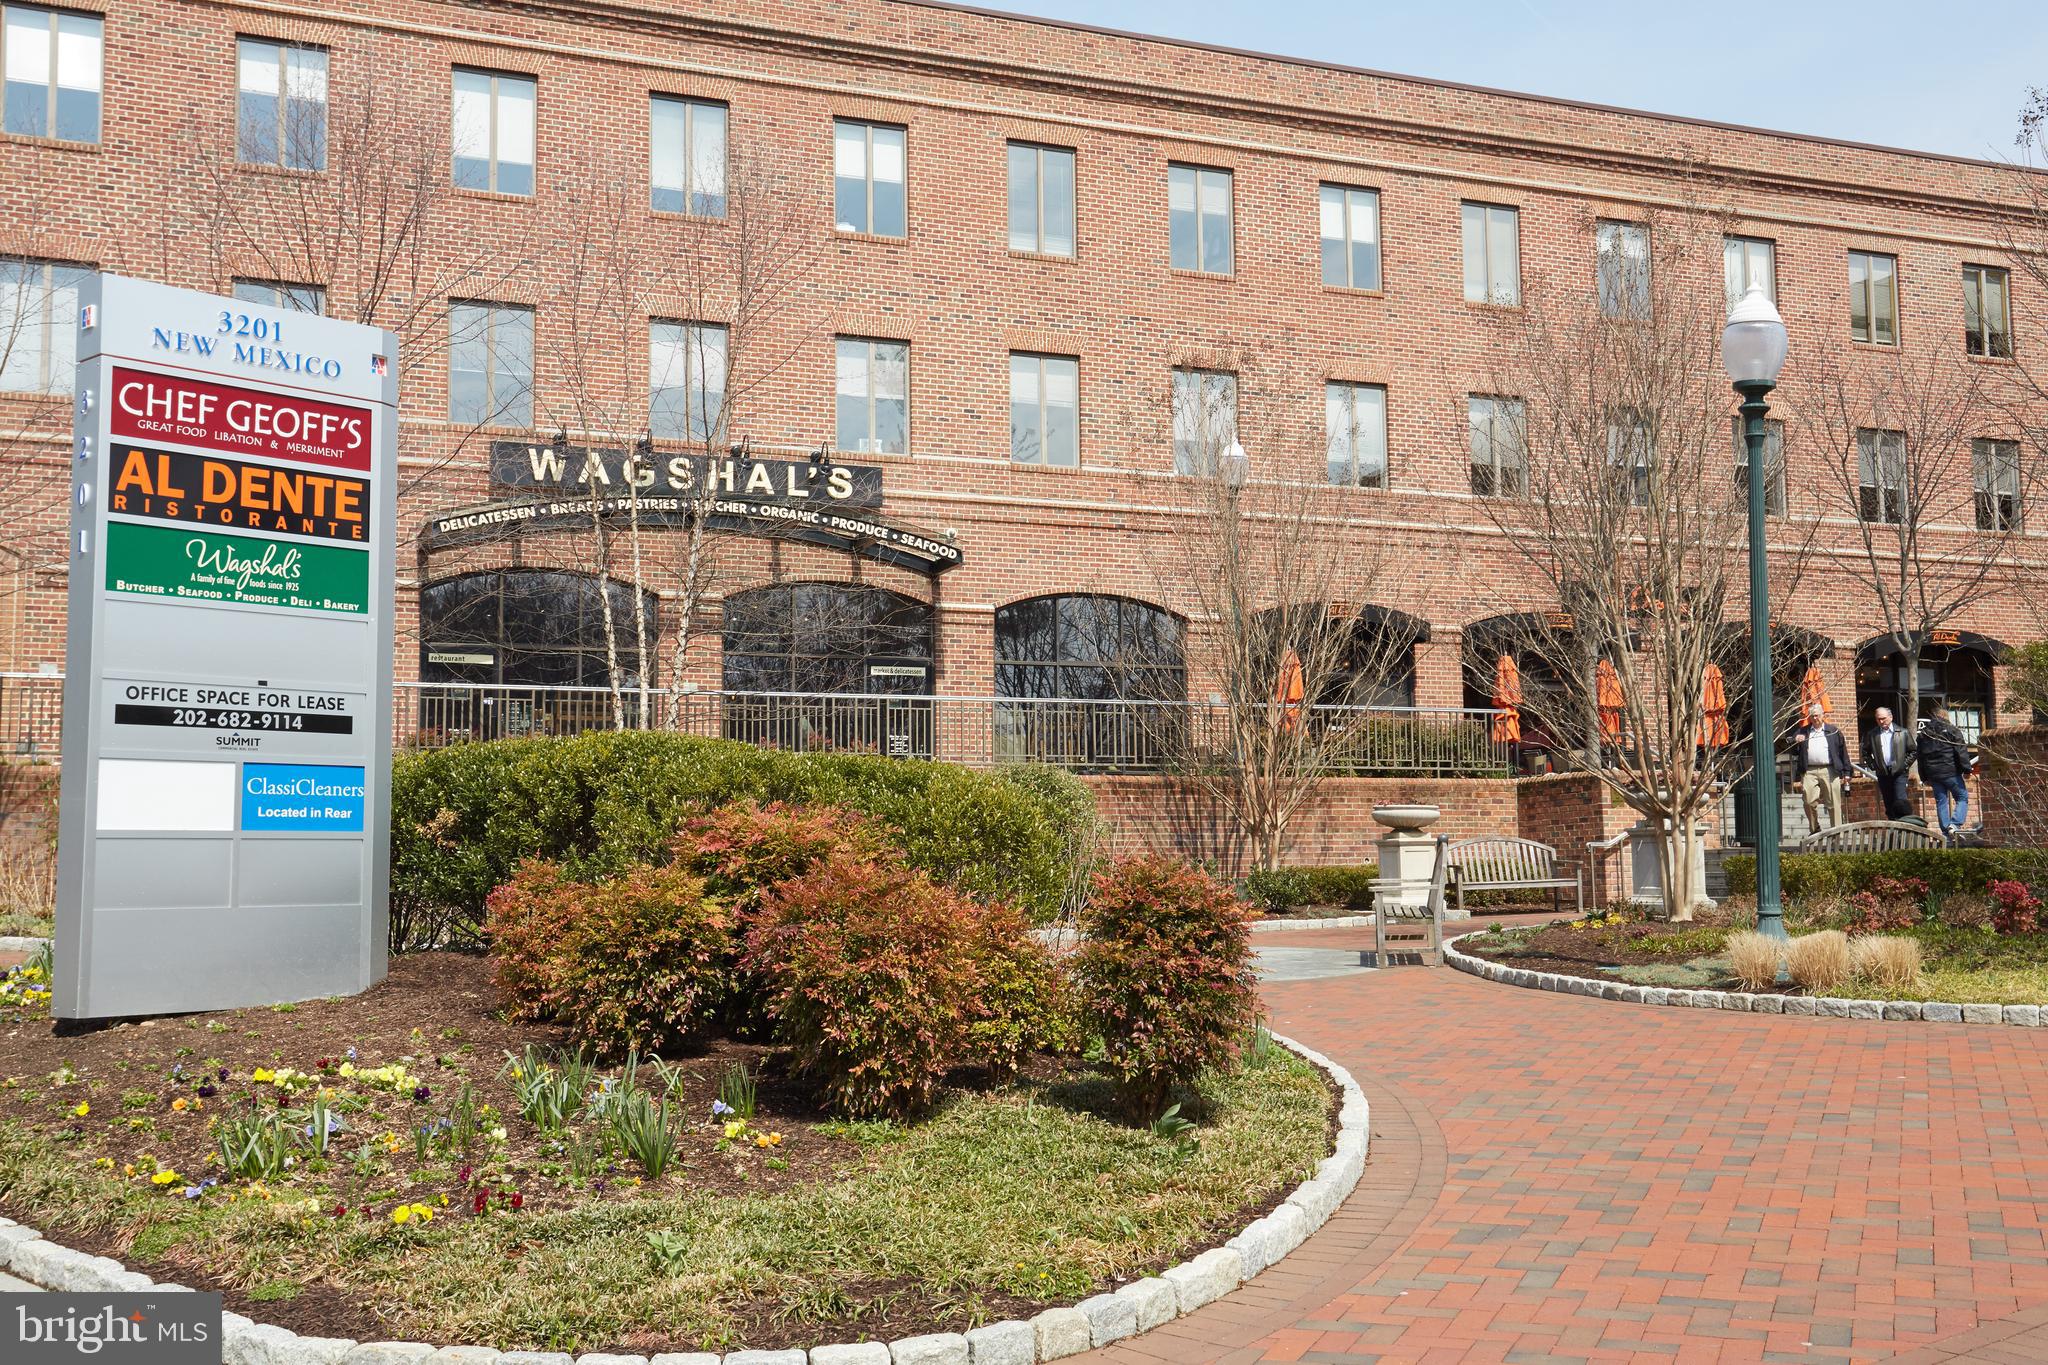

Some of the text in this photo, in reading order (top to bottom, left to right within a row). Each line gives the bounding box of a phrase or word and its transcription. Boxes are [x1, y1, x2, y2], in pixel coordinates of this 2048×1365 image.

[218, 311, 281, 341] 3201
[152, 327, 218, 356] NEW
[234, 343, 341, 378] MEXICO
[119, 382, 362, 449] CHEF GEOFF'S
[137, 419, 345, 459] GREAT FOOD LIBATION & MERRIMENT
[116, 450, 363, 522] AL DENTE
[528, 447, 853, 500] WAGSHAL'S
[114, 494, 362, 539] RISTORANTE
[439, 506, 536, 533] DELICATESSEN
[617, 498, 678, 510] PASTRIES
[691, 500, 747, 514] BCHER
[760, 505, 819, 524] ORGANIC
[831, 516, 888, 539] PRODUCE
[900, 533, 957, 559] SEAFOOD
[185, 539, 302, 590] Wagshal's
[190, 573, 299, 591] A family of fine foods since 1925
[116, 579, 360, 611] BUTCHER SEAFOOD PRODUCE DELI BAKERY
[126, 685, 345, 711] OFFICE SPACE FOR LEASE
[173, 709, 303, 731] 202-682-9114
[216, 736, 261, 746] SUMMIT
[247, 777, 364, 798] ClassiCleaners
[257, 806, 352, 819] Located in Rear
